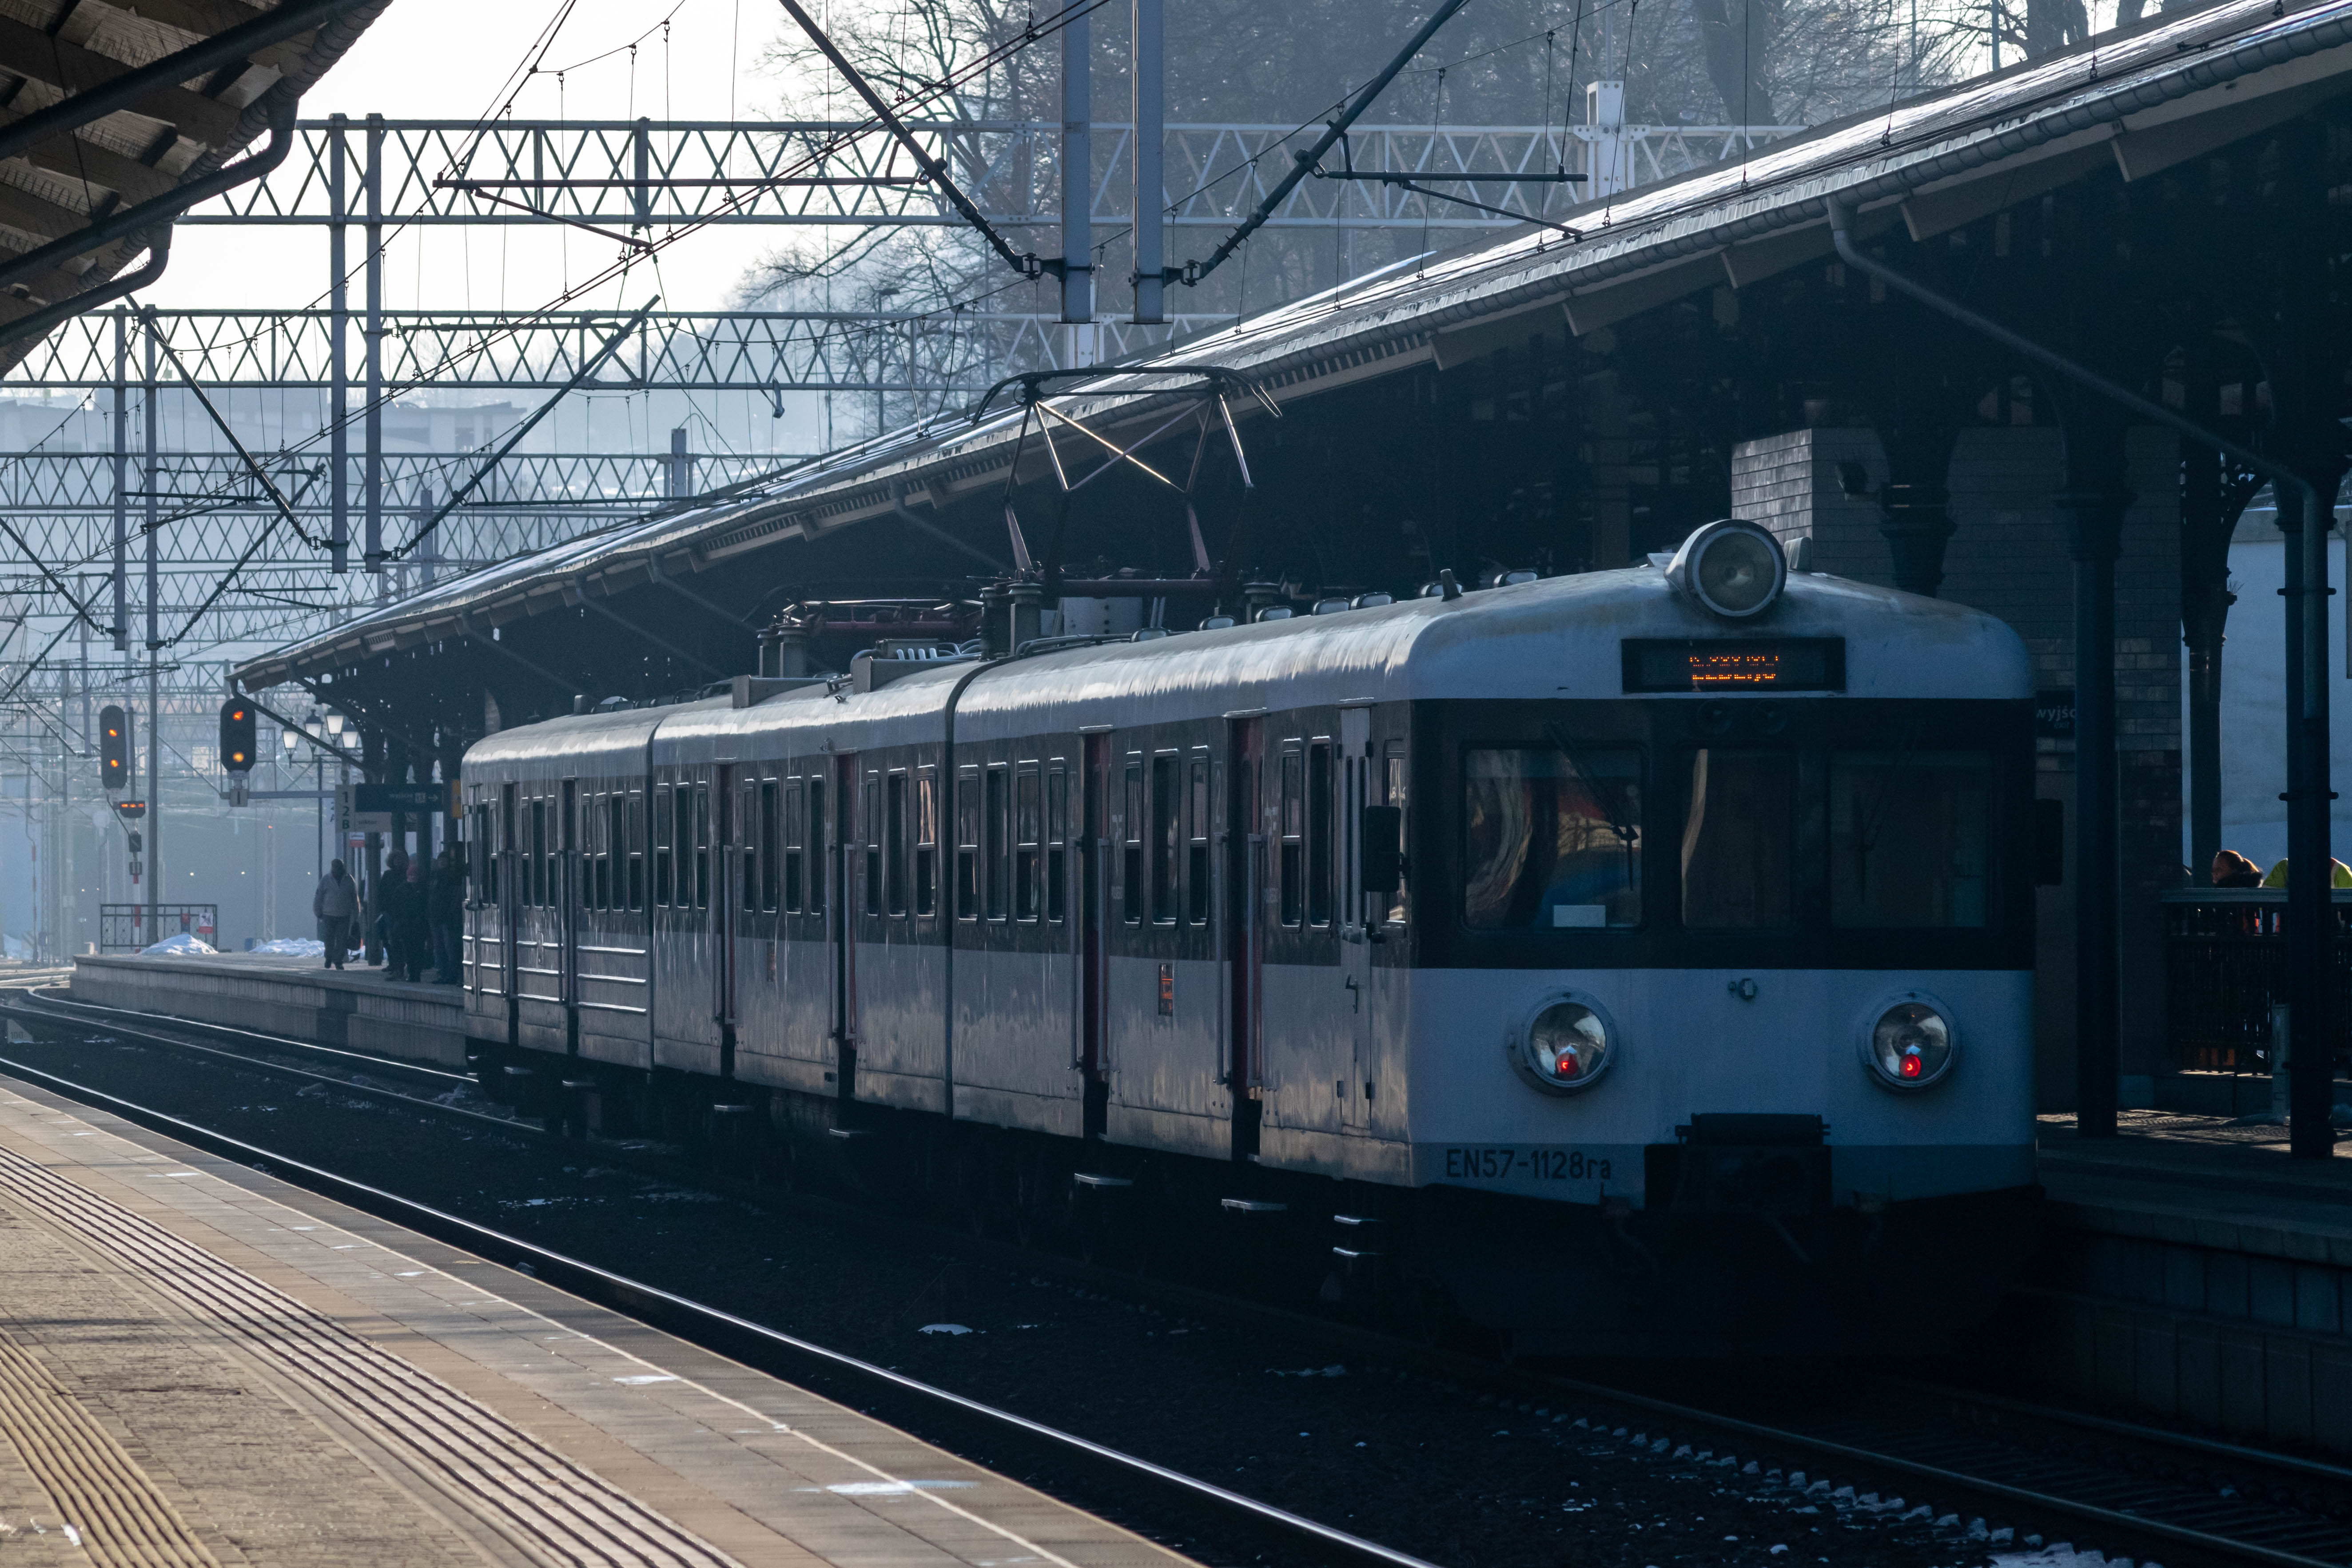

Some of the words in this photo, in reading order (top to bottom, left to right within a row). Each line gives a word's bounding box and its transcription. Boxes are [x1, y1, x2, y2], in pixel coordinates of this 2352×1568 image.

[342, 792, 348, 803] 1
[342, 805, 350, 816] 2
[342, 819, 350, 830] B
[1446, 1148, 1612, 1180] EN57-1128ra
